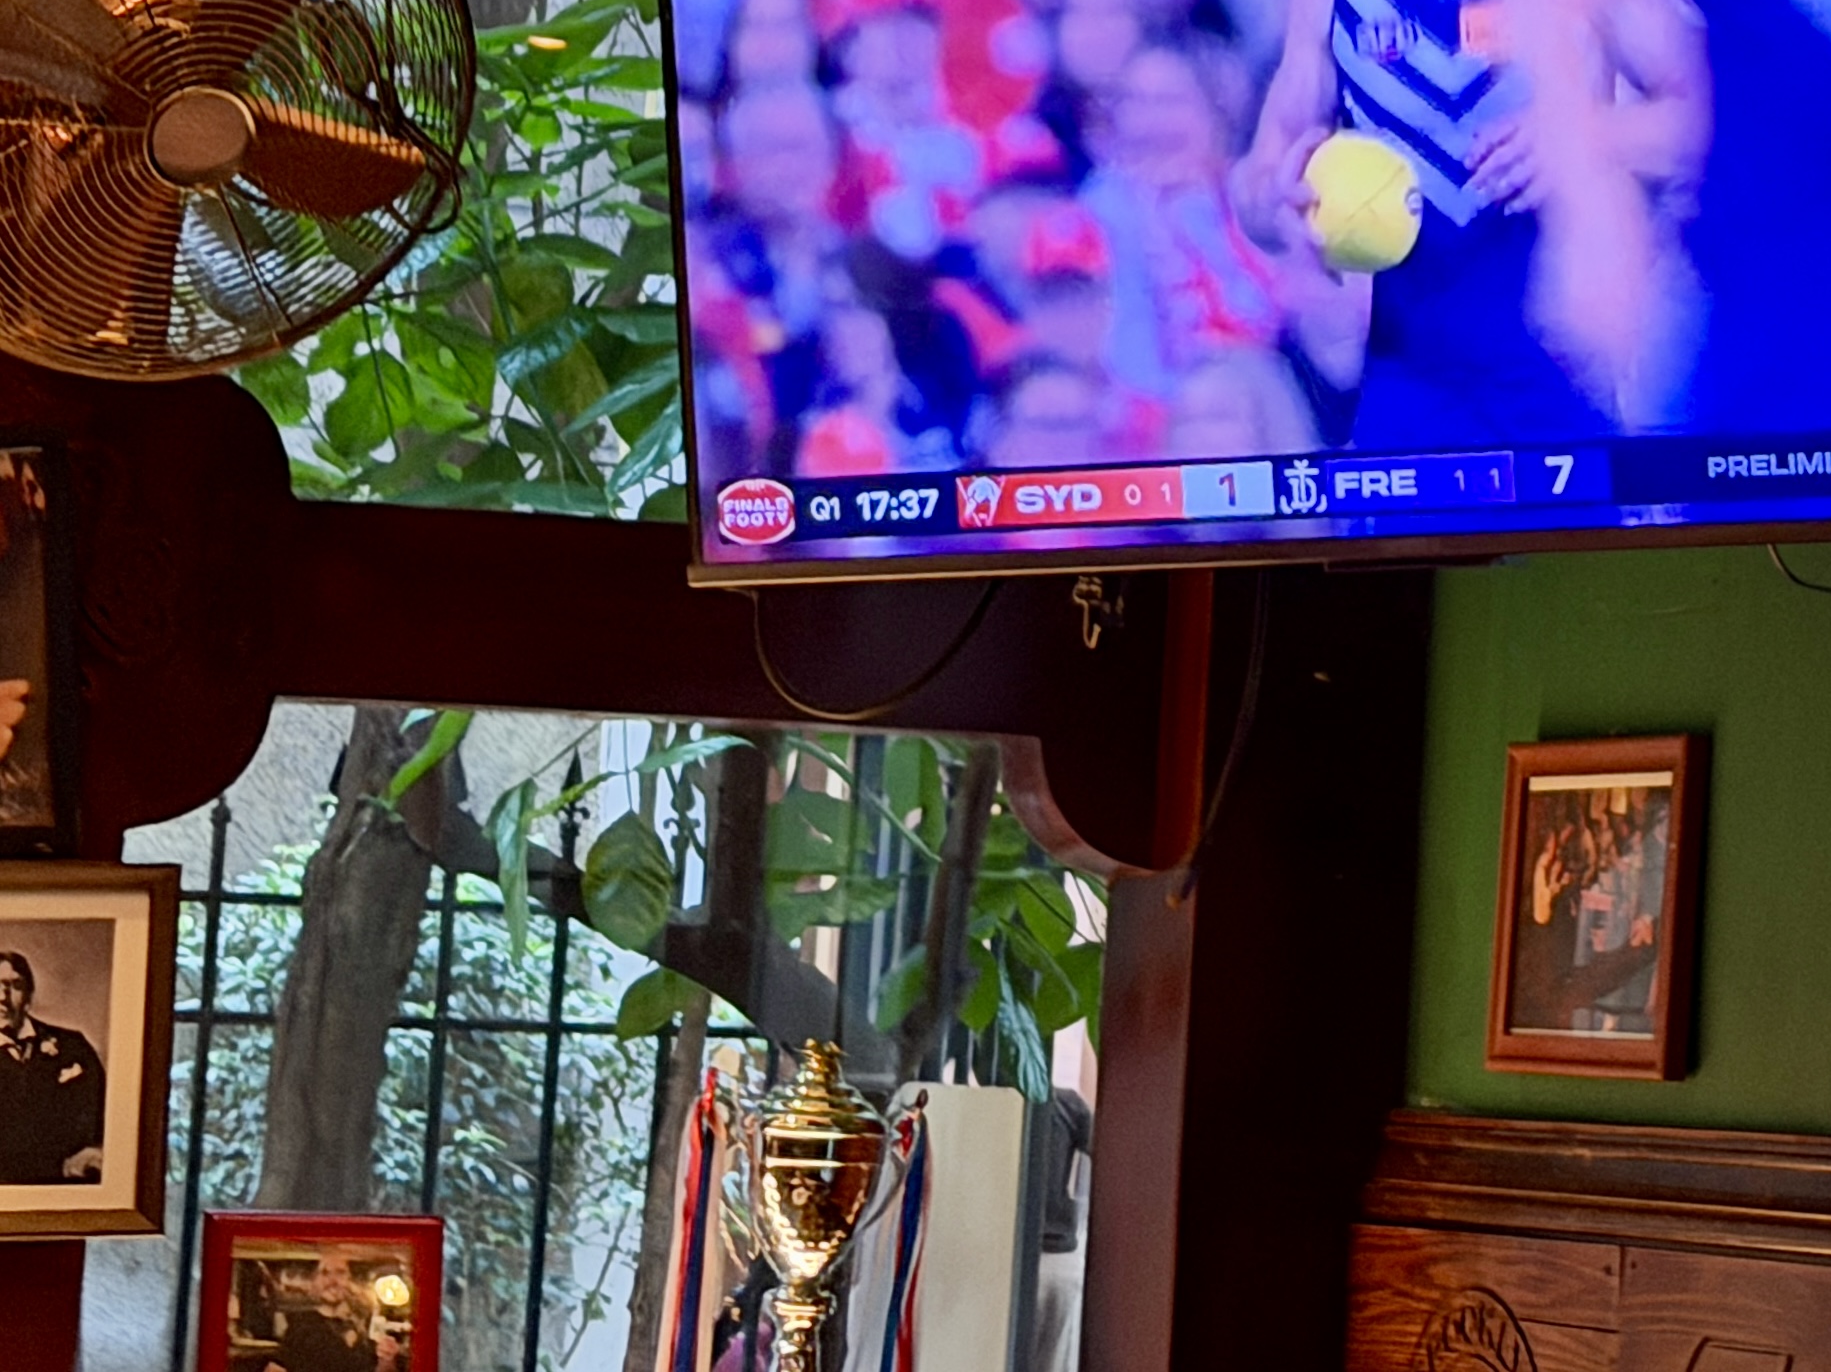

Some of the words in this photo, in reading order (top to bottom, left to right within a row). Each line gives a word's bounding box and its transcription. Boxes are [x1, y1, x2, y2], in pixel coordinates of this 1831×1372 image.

[1014, 478, 1102, 515] SYD
[1159, 481, 1174, 504] 1
[1218, 472, 1237, 508] 1
[1333, 467, 1418, 500] FRE
[1544, 454, 1575, 495] 7
[809, 495, 842, 522] Q1
[855, 487, 940, 522] 17:37
